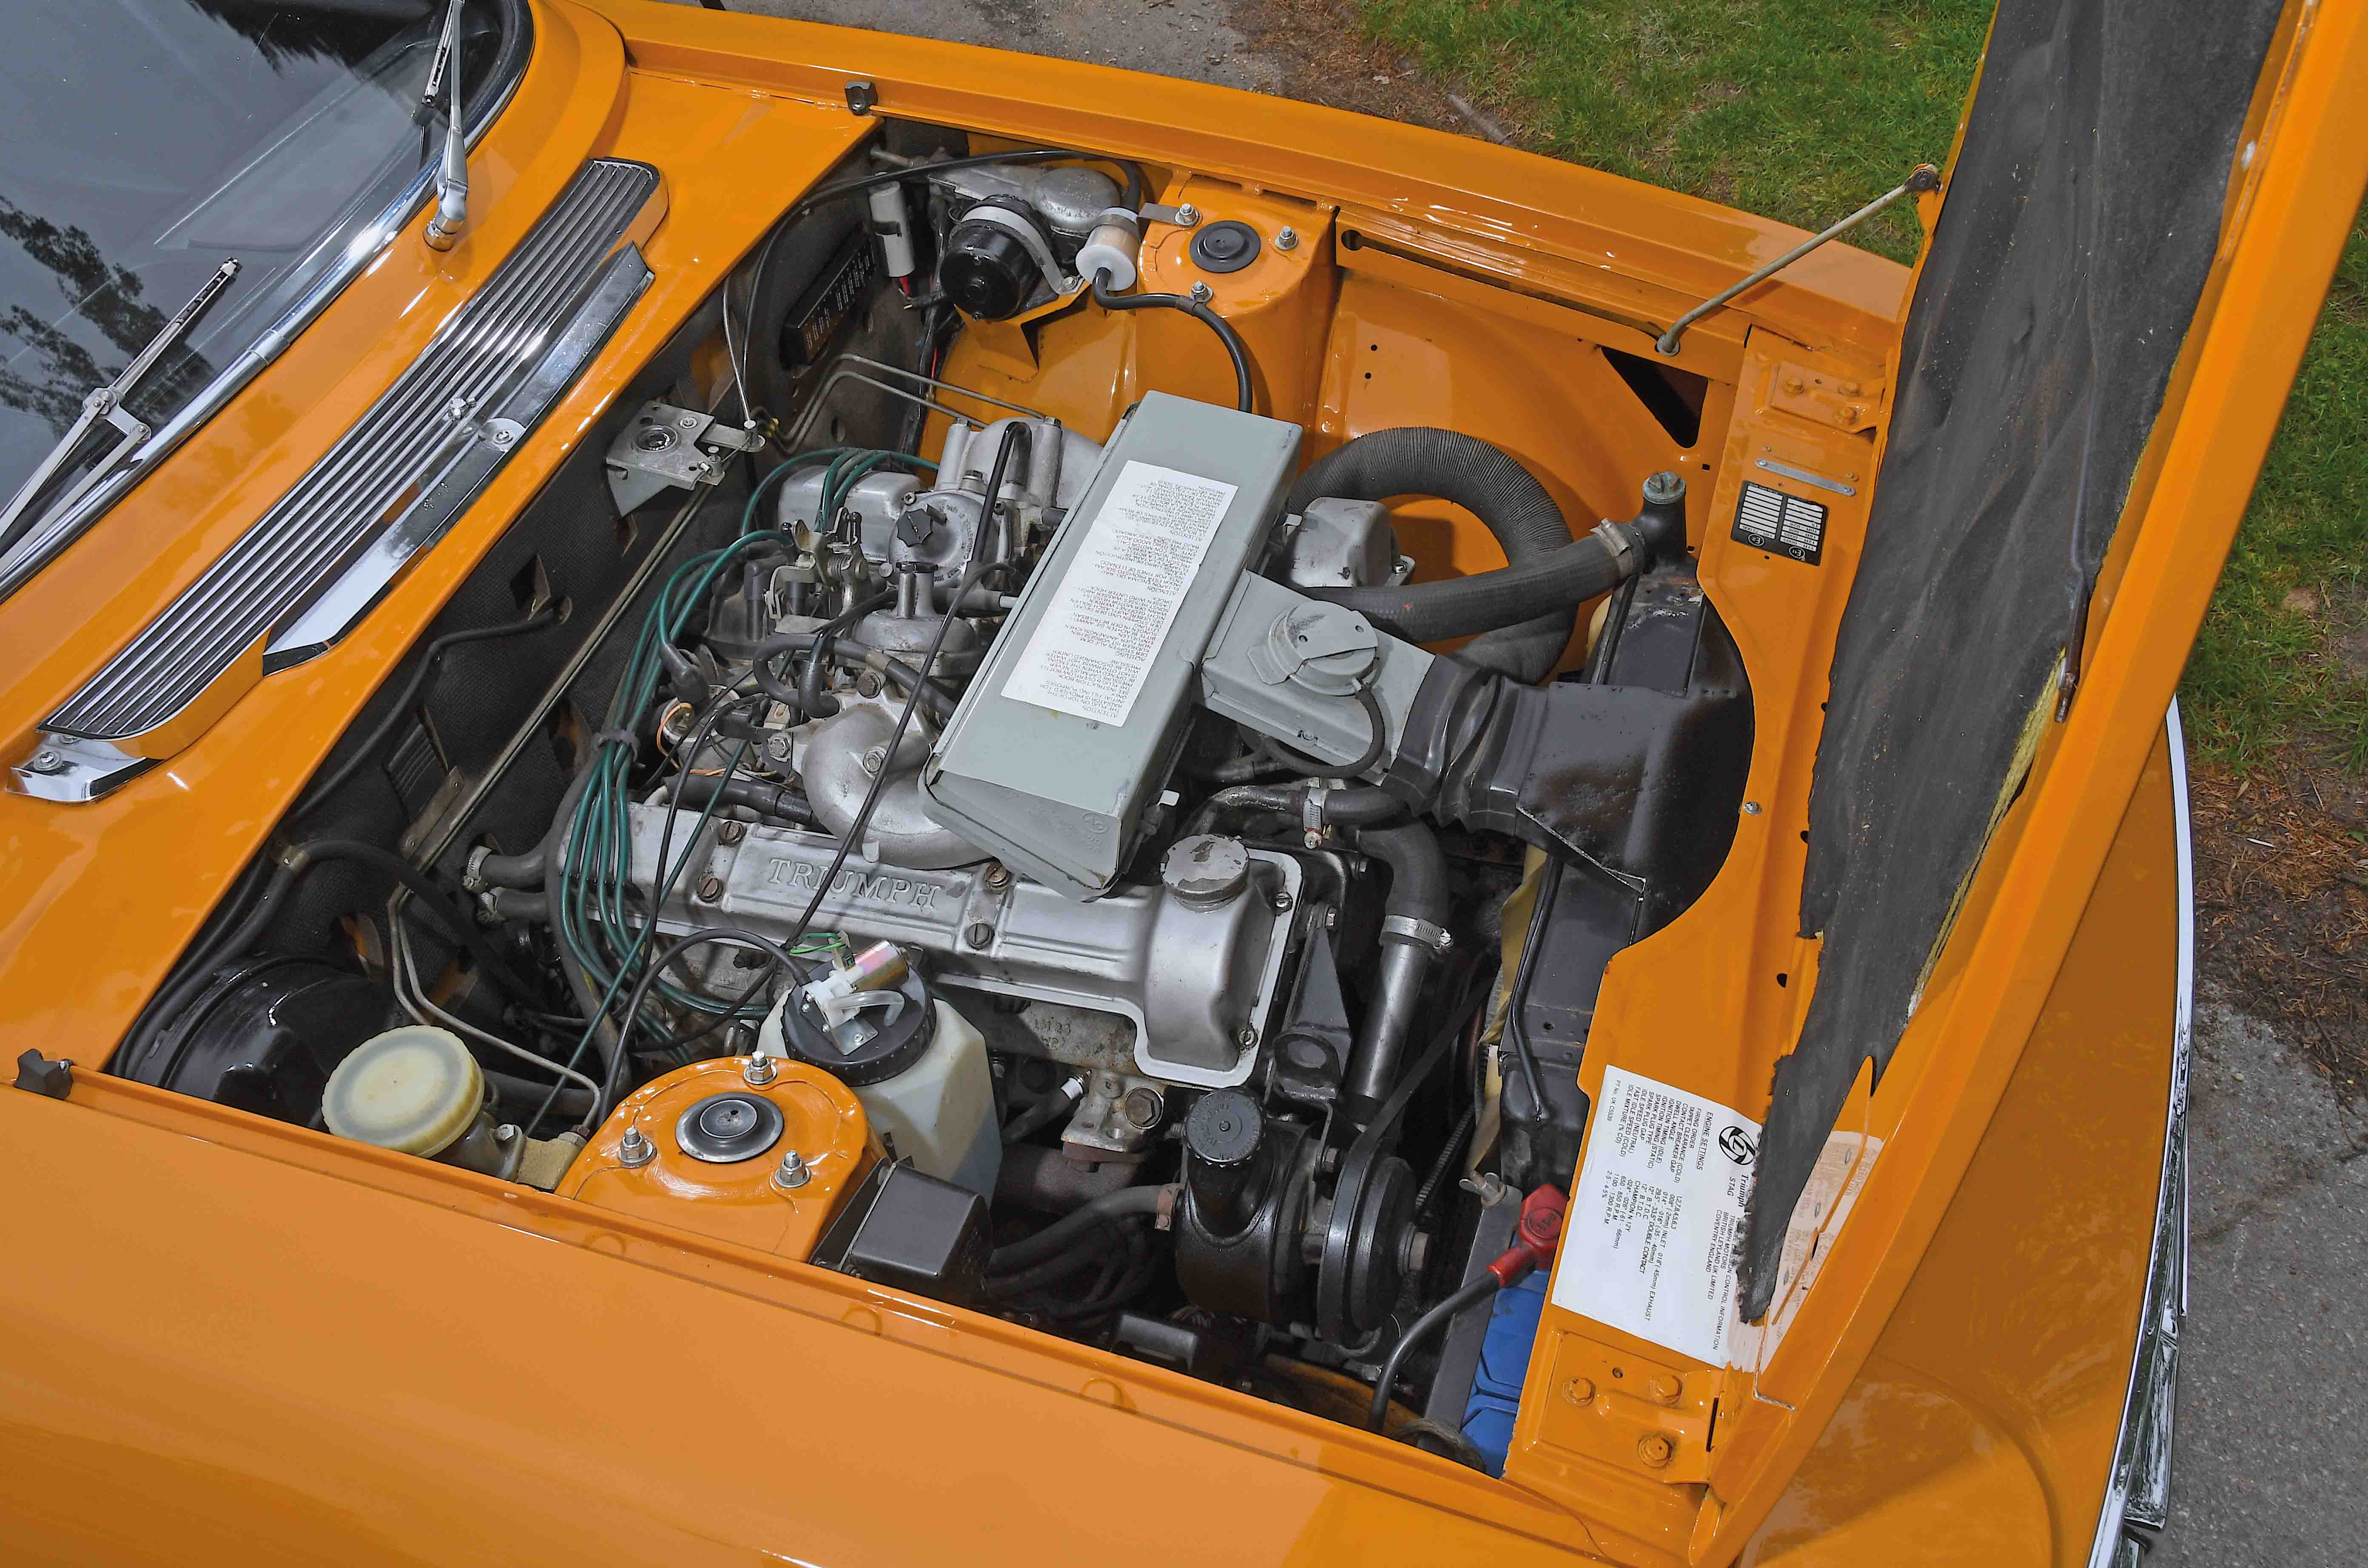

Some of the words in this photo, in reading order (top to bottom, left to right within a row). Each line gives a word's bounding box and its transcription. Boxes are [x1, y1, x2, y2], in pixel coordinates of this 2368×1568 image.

[1074, 655, 1113, 668] DISCHARGED
[1116, 651, 1146, 662] ACHTUNG
[1082, 662, 1117, 673] OTHERWISE
[1076, 679, 1116, 692] INSTRUCTION
[1102, 676, 1133, 687] PRESSURE
[1054, 688, 1084, 698] PROVIDED
[1091, 697, 1122, 707] RADIATOR
[1082, 706, 1117, 718] ATTENTION
[1620, 1098, 1631, 1123] MIXTURE
[1646, 1091, 1654, 1112] SPARK
[1653, 1094, 1661, 1113] SPARK
[1658, 1096, 1667, 1121] IGNITION
[1665, 1098, 1674, 1124] IGNITION
[1673, 1101, 1681, 1119] DWELL
[1636, 1102, 1645, 1122] SPEED
[1642, 1111, 1651, 1127] PLUG
[1649, 1114, 1657, 1129] PLUG
[1678, 1103, 1688, 1131] CONTACT
[1686, 1107, 1694, 1126] TAPPET
[1693, 1108, 1701, 1127] FIRING
[1625, 1116, 1634, 1135] SPEED
[1654, 1122, 1662, 1142] TIMING
[1668, 1121, 1676, 1141] ANGLE
[1703, 1112, 1713, 1137] ENGINE
[1628, 1123, 1640, 1153] (NEUTRAL)
[1660, 1125, 1669, 1145] TIMING
[1672, 1131, 1682, 1159] BREAKER
[1679, 1127, 1691, 1162] CLEARANCE
[1689, 1128, 1697, 1148] ORDER
[1619, 1136, 1629, 1156] (COLD)
[1647, 1143, 1658, 1168] (STATIC)
[1655, 1146, 1664, 1163] (IDLE)
[1696, 1136, 1708, 1170] SETTINGS
[1674, 1163, 1682, 1183] (COLD)
[1728, 1177, 1736, 1196] STAG
[1737, 1174, 1748, 1208] Triumph
[1629, 1181, 1640, 1213] CHAMPION
[1645, 1221, 1654, 1245] DOUBLE
[1712, 1210, 1722, 1242] COVENTRY
[1720, 1212, 1728, 1236] BRITISH
[1726, 1215, 1735, 1241] TRIUMPH
[1706, 1243, 1716, 1272] ENGLAND
[1715, 1236, 1724, 1264] LEYLAND
[1721, 1243, 1730, 1269] MOTORS
[1640, 1247, 1649, 1274] CONTACT
[1712, 1265, 1718, 1274] UK
[1708, 1275, 1716, 1299] LIMITED
[1721, 1275, 1731, 1304] CONTROL
[1645, 1291, 1655, 1321] EXHAUST
[1713, 1306, 1725, 1349] INFORMATION
